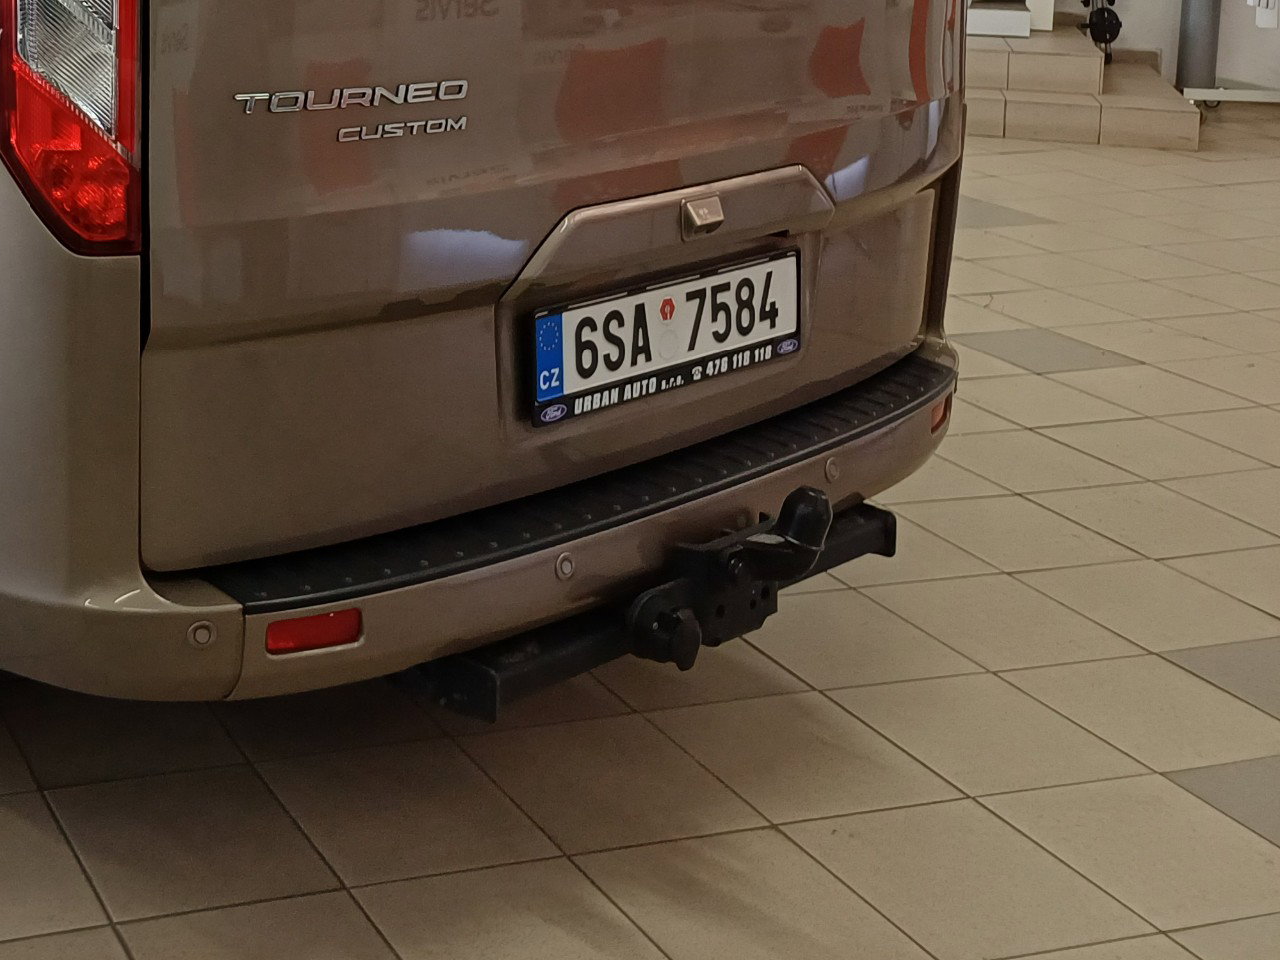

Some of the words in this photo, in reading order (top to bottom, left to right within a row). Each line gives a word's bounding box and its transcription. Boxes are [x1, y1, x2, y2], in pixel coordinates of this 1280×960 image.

[234, 79, 469, 114] TOURNEO
[337, 116, 468, 142] CUSTOM
[575, 303, 652, 379] 6SA
[685, 271, 779, 352] 7584
[539, 368, 560, 390] CZ
[574, 387, 619, 415] URBAN
[623, 377, 657, 401] AUTO
